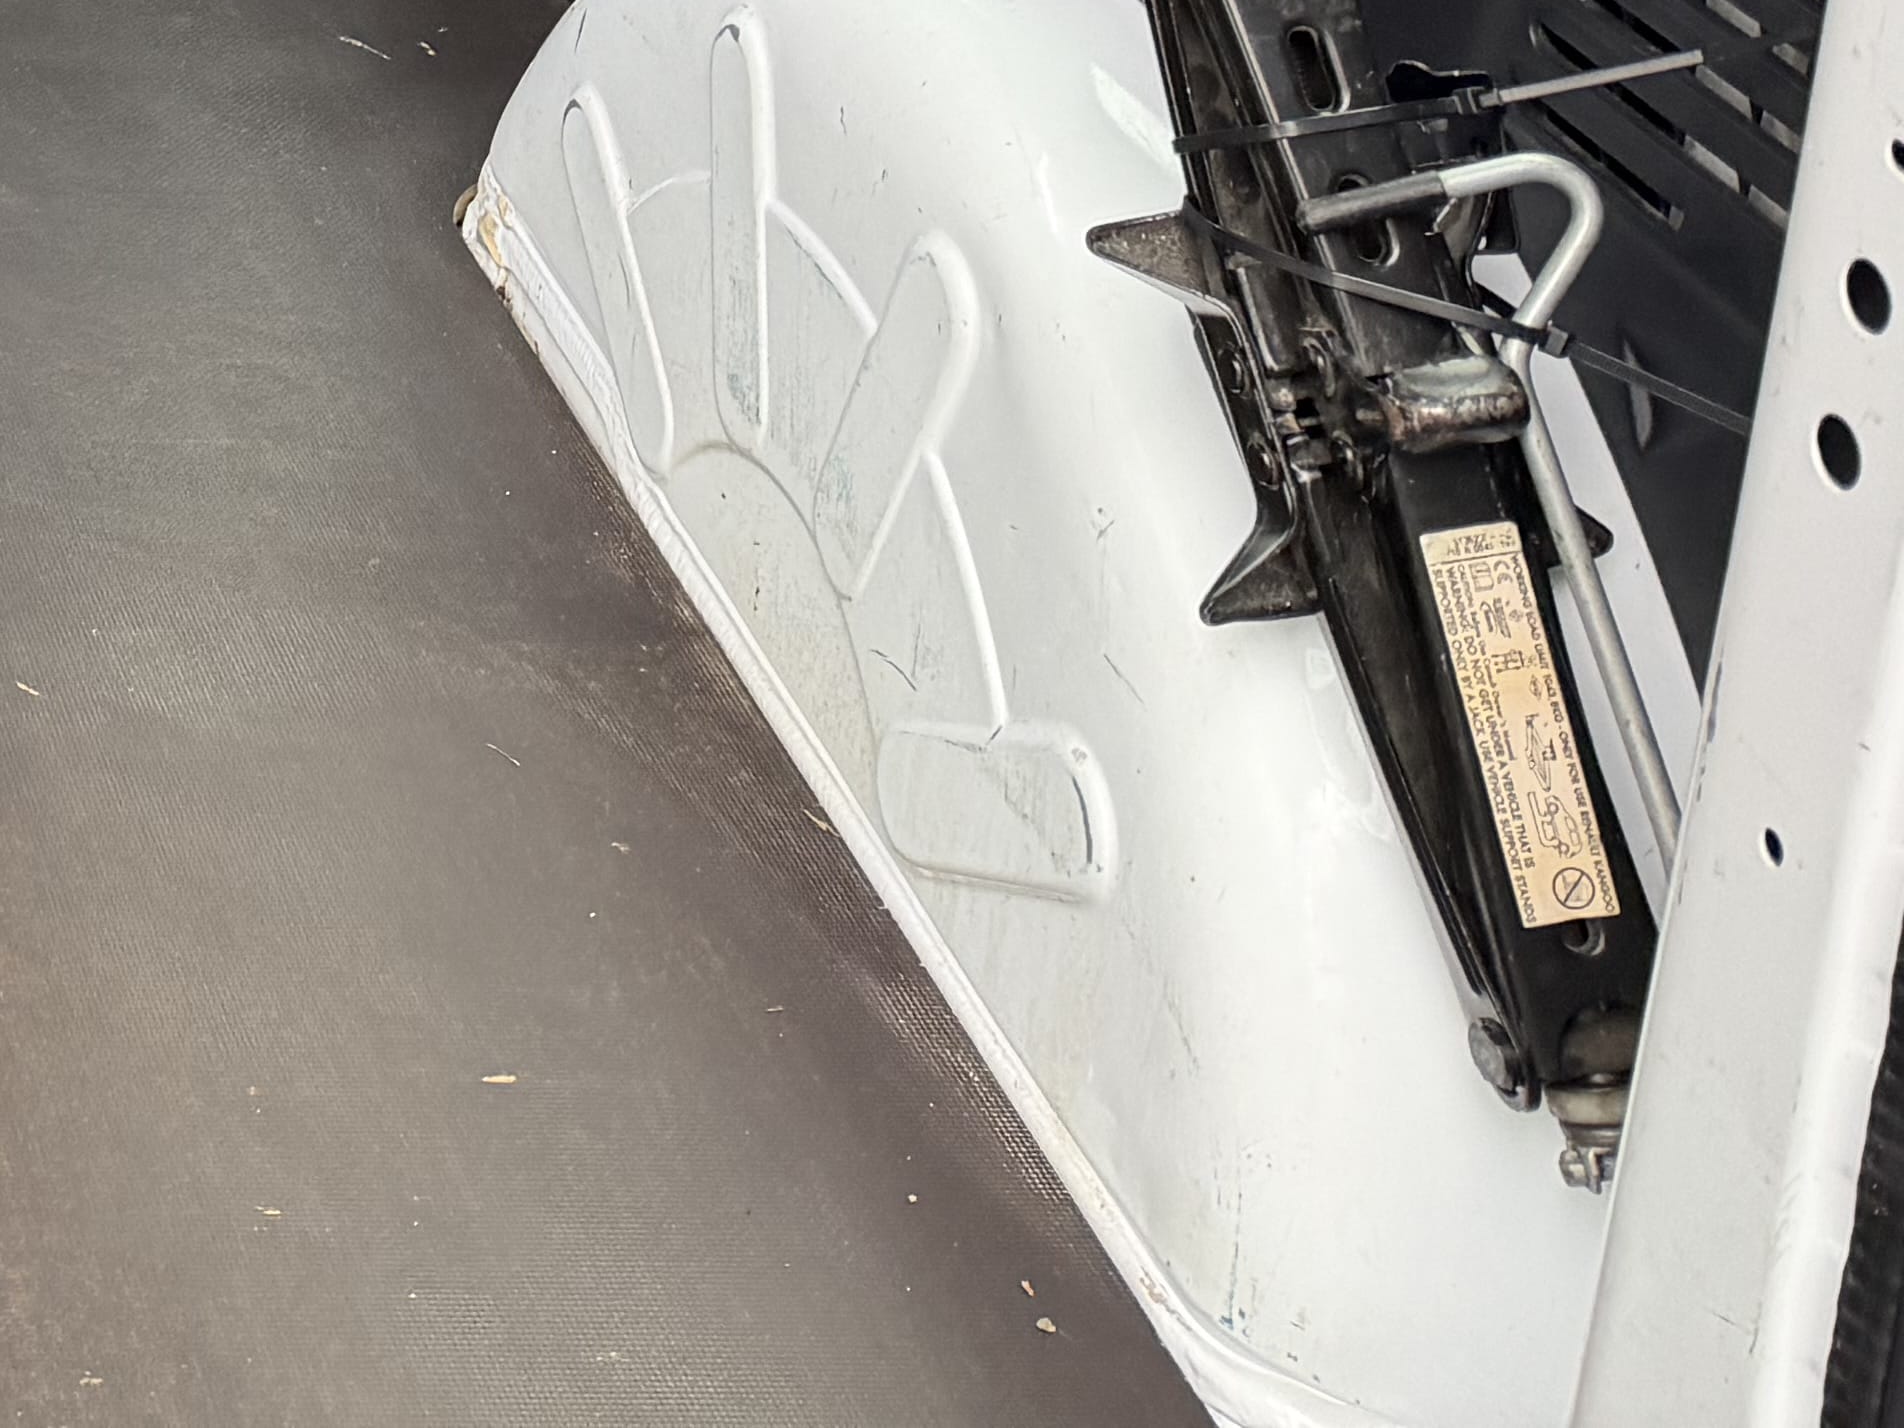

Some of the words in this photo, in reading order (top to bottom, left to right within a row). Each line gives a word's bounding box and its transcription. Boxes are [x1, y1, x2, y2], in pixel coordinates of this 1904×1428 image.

[1509, 554, 1533, 608] WORKING
[1431, 568, 1459, 636] SUPPORTED
[1525, 610, 1541, 641] LOAD
[1450, 639, 1468, 671] ONLY
[1463, 635, 1478, 655] DO
[1533, 643, 1549, 669] LIMIT
[1460, 675, 1473, 689] BY
[1469, 658, 1486, 686] NOT
[1465, 693, 1476, 702] A
[1477, 688, 1493, 712] GET
[1484, 714, 1505, 757] UNDER
[1557, 730, 1574, 760] ONLY
[1478, 740, 1493, 762] USE
[1497, 759, 1508, 770] A
[1566, 762, 1580, 784] FOR
[1484, 765, 1507, 814] VEHICLE
[1500, 771, 1522, 820] VEHICLE
[1573, 787, 1587, 807] USE
[1499, 818, 1522, 871] SUPPORT
[1514, 823, 1531, 854] THAT
[1579, 810, 1600, 856] RENAULT
[1523, 857, 1536, 868] IS
[1514, 874, 1536, 922] STANDS
[1592, 859, 1616, 913] KANGOO
